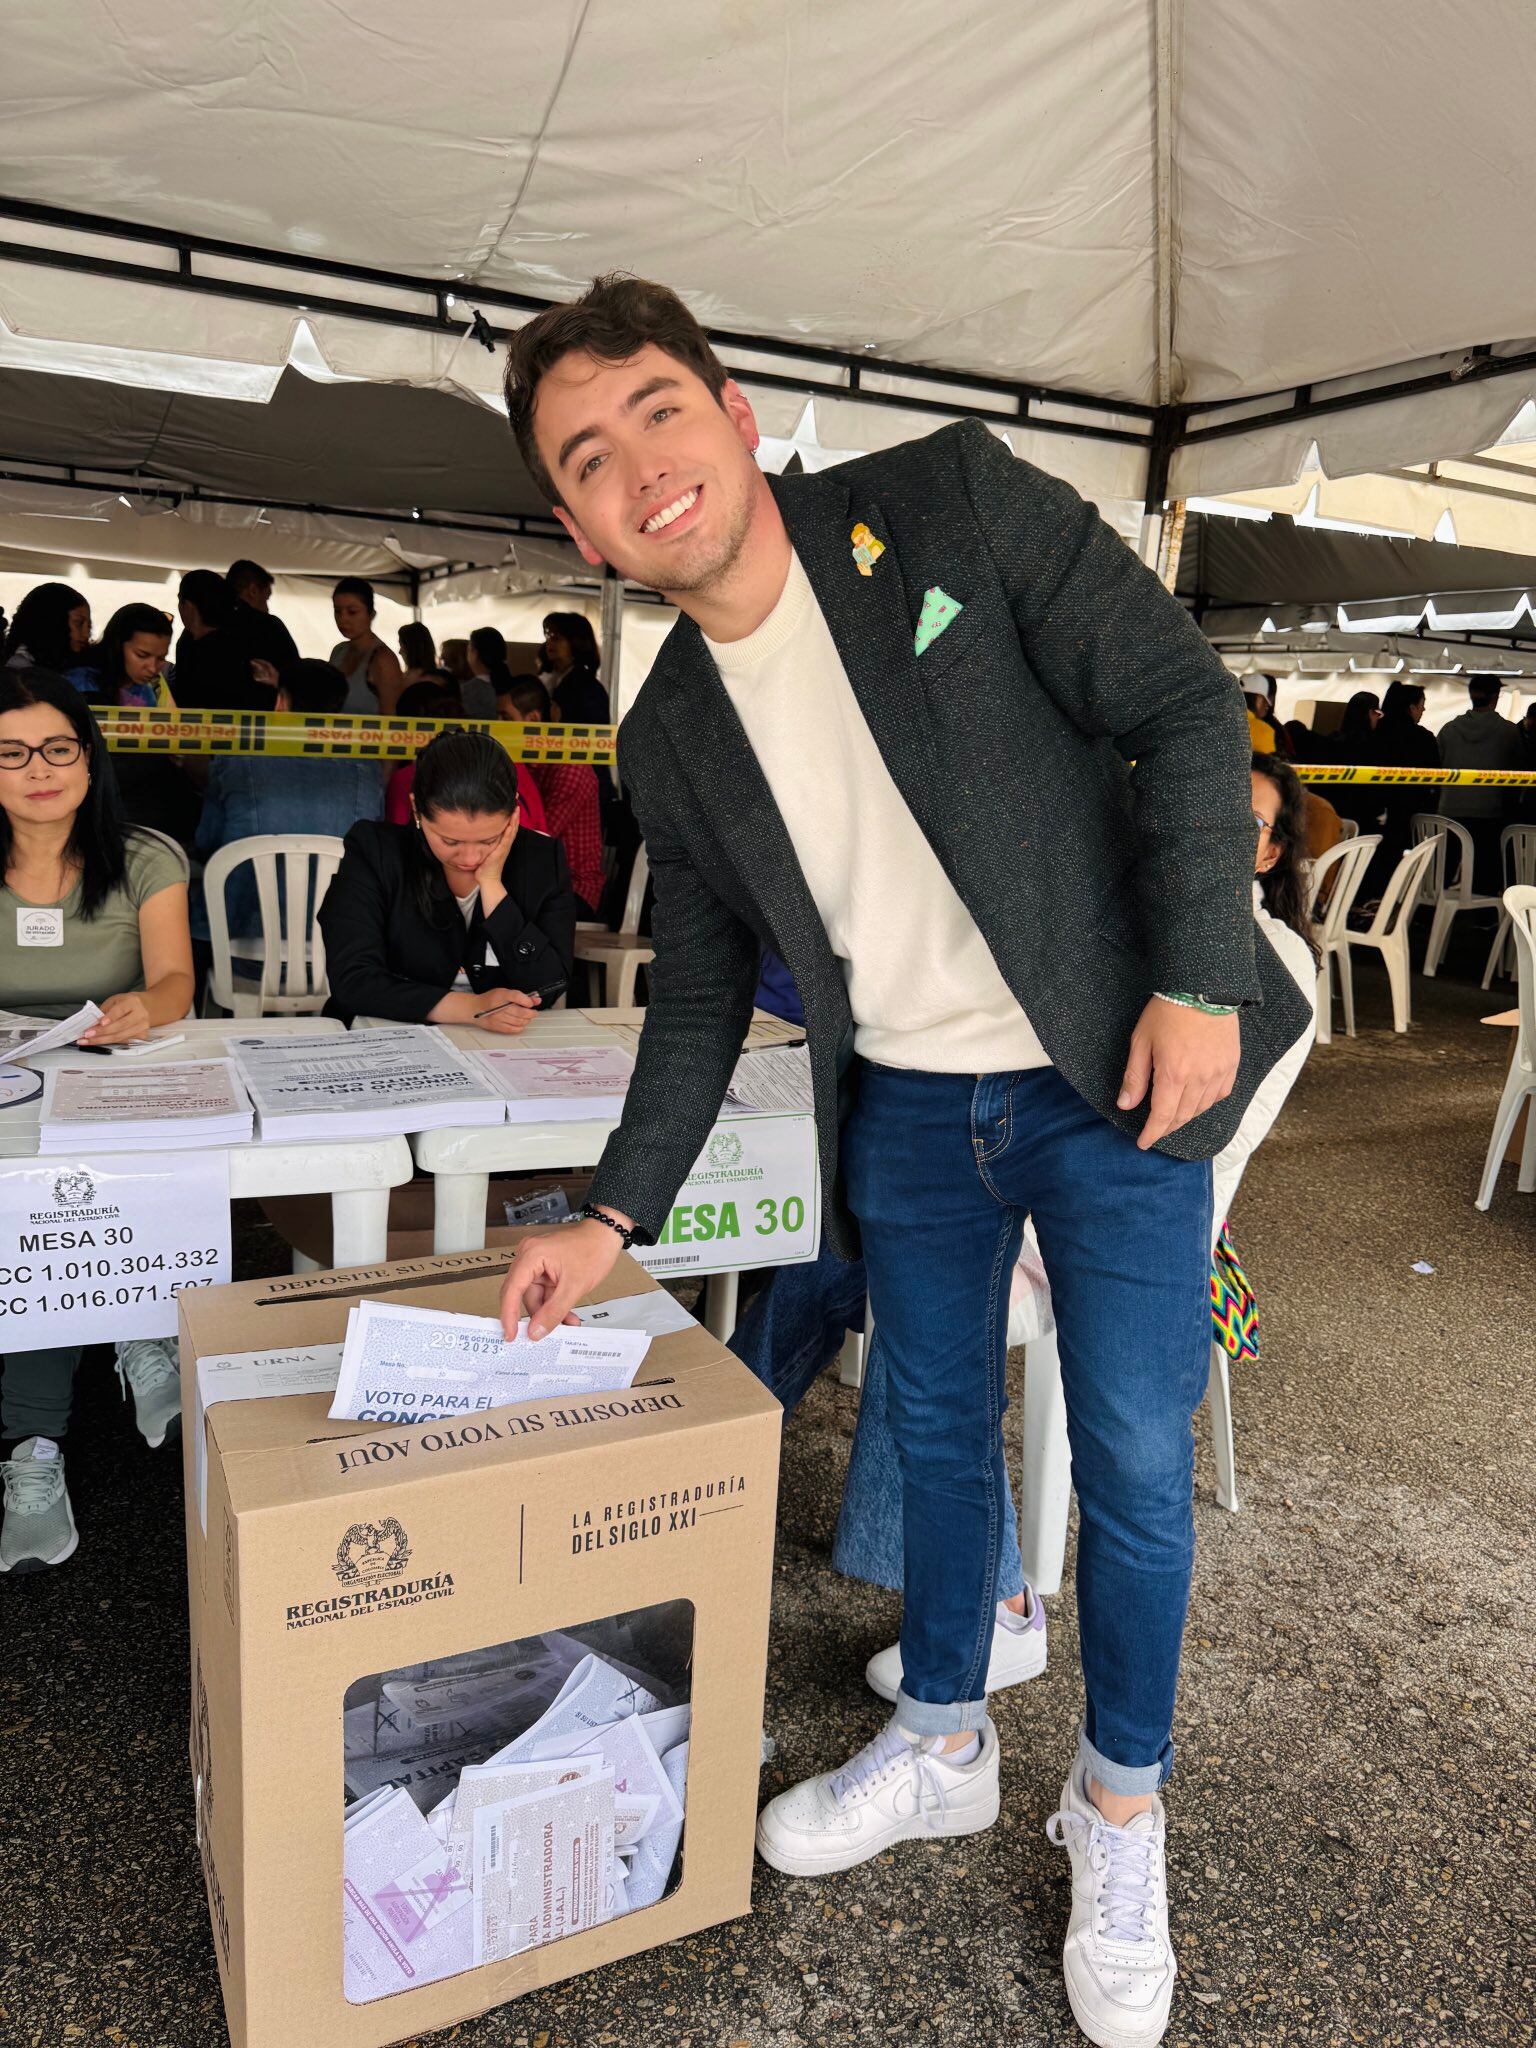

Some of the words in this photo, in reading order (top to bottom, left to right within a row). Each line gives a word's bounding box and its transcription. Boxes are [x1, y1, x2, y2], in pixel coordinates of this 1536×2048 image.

[114, 723, 144, 736] NO
[151, 723, 236, 738] PELIGRO
[307, 729, 352, 743] PASE
[359, 730, 384, 743] NO
[525, 737, 564, 750] PASE
[569, 739, 591, 750] NO
[272, 1083, 364, 1092] CAPITAL
[371, 1072, 465, 1085] DISTRITO
[371, 1077, 468, 1089] CONCEJO
[29, 1204, 120, 1221] REGISTRADURÍA
[755, 1196, 805, 1236] 30
[19, 1230, 96, 1253] MESA
[103, 1226, 133, 1246] 30
[0, 1266, 33, 1285] CC
[41, 1248, 219, 1281] 1.010.304.332
[267, 1269, 390, 1293] DEPOSITE
[395, 1263, 426, 1276] SU
[431, 1255, 492, 1269] VOTO
[430, 1331, 457, 1350] 29
[472, 1335, 505, 1345] OCTUBRE
[253, 1355, 316, 1367] URNA
[365, 1389, 417, 1406] VOTO
[420, 1394, 470, 1409] PARA
[551, 1394, 685, 1428] DEPOSITE
[507, 1414, 545, 1436] SU
[420, 1423, 502, 1452] VOTO
[337, 1439, 410, 1474] AQUÍ
[573, 1510, 592, 1529] LA
[604, 1475, 746, 1522] REGISTRADURÍA
[572, 1529, 605, 1555] DEL
[609, 1515, 661, 1546] SIGLO
[668, 1507, 697, 1532] XXI
[343, 1573, 376, 1586] ORGANIZACIÓN
[376, 1570, 401, 1579] ELECTORAL
[286, 1571, 455, 1620] REGISTRADURÍA
[286, 1611, 347, 1631] NACIONAL
[350, 1605, 375, 1617] DEL
[377, 1595, 423, 1611] ESTADO
[425, 1587, 455, 1601] CIVIL
[543, 1821, 553, 1929] ADMINISTRADORA
[555, 1887, 567, 1927] (J.A.L.)
[528, 1916, 538, 1944] PARA
[365, 1909, 372, 1917] DE
[386, 1939, 399, 1957] ANULA
[401, 1960, 412, 1976] VOTO
